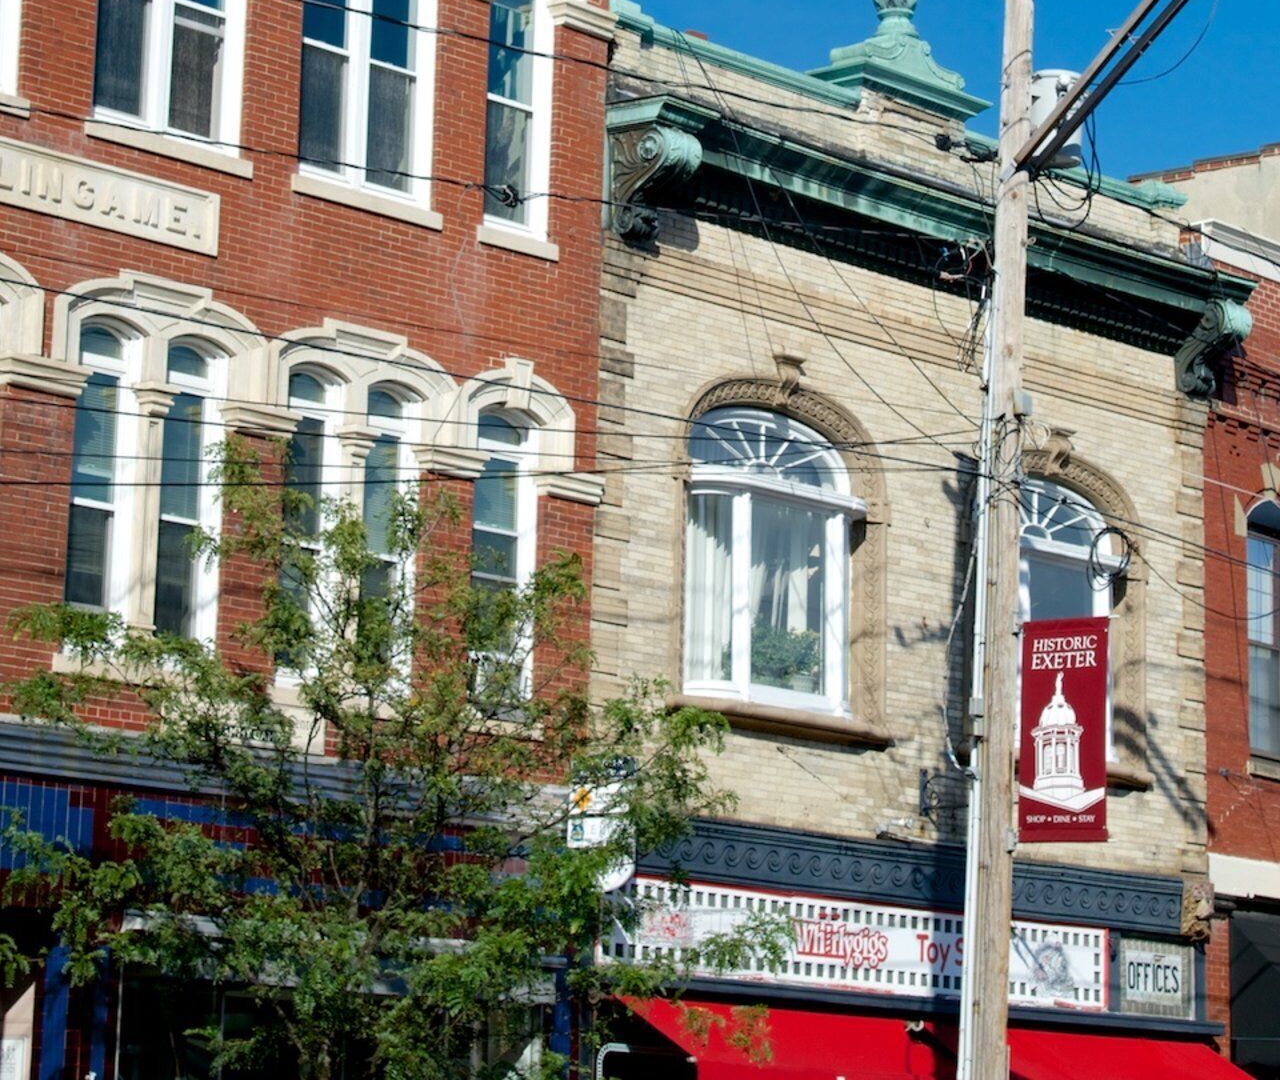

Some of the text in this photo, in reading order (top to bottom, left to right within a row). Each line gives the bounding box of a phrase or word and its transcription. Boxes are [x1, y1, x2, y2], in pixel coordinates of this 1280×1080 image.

[1032, 635, 1097, 653] HISTORIC
[1031, 651, 1097, 670] EXETER
[1026, 814, 1096, 824] SHOP DINE STAY
[795, 919, 888, 969] Whirlygigs
[916, 933, 951, 972] Toy
[1127, 961, 1180, 994] OFFICES
